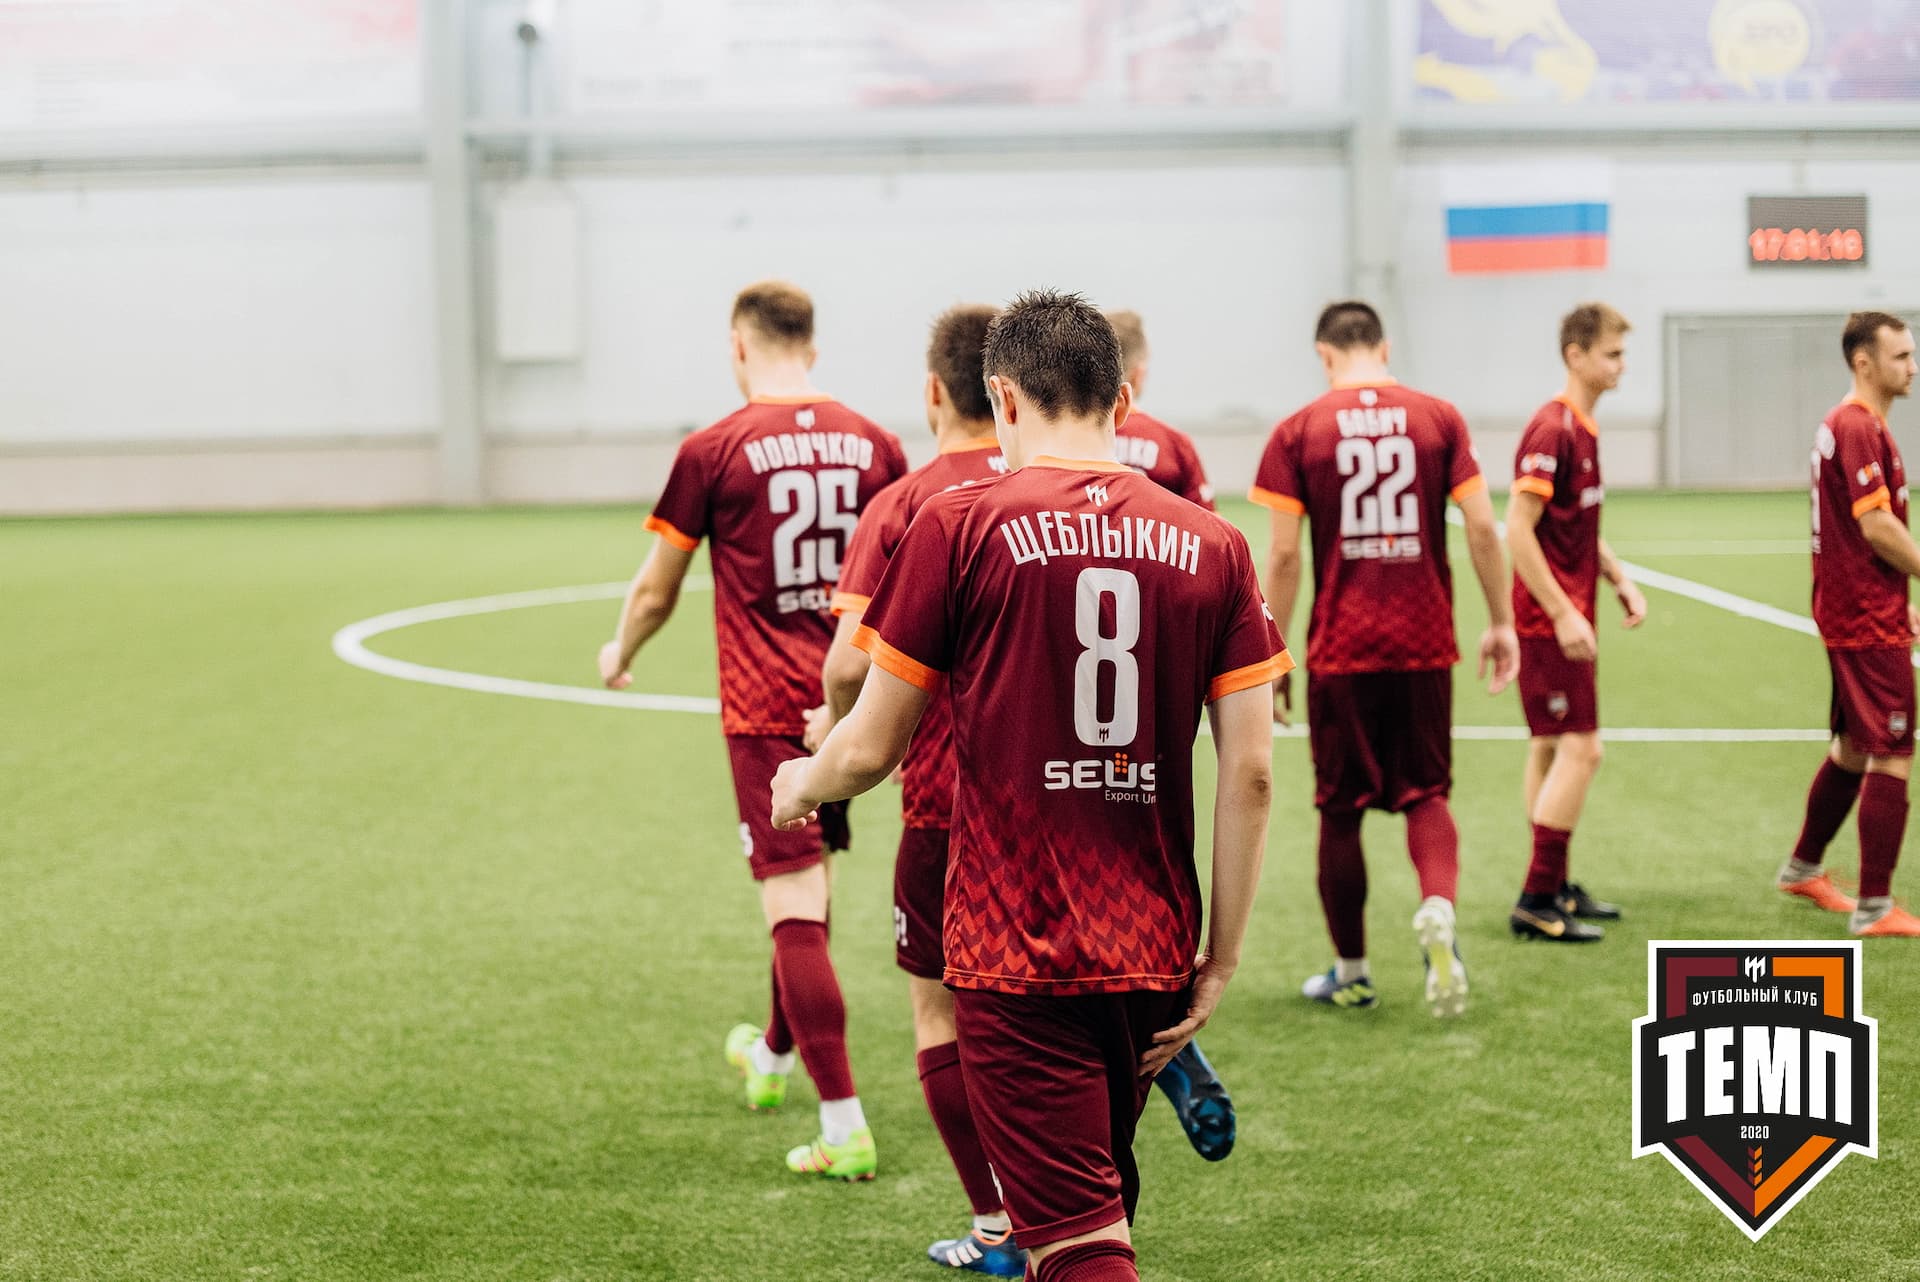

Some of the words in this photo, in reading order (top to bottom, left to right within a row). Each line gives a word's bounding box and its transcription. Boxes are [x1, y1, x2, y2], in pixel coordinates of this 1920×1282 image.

[744, 432, 874, 475] НОВИЧКОВ
[1336, 435, 1420, 538] 22
[768, 469, 860, 588] 25
[1000, 511, 1201, 576] ЩЕБЛЫКИН
[1075, 567, 1140, 746] 8
[1105, 790, 1139, 803] Export
